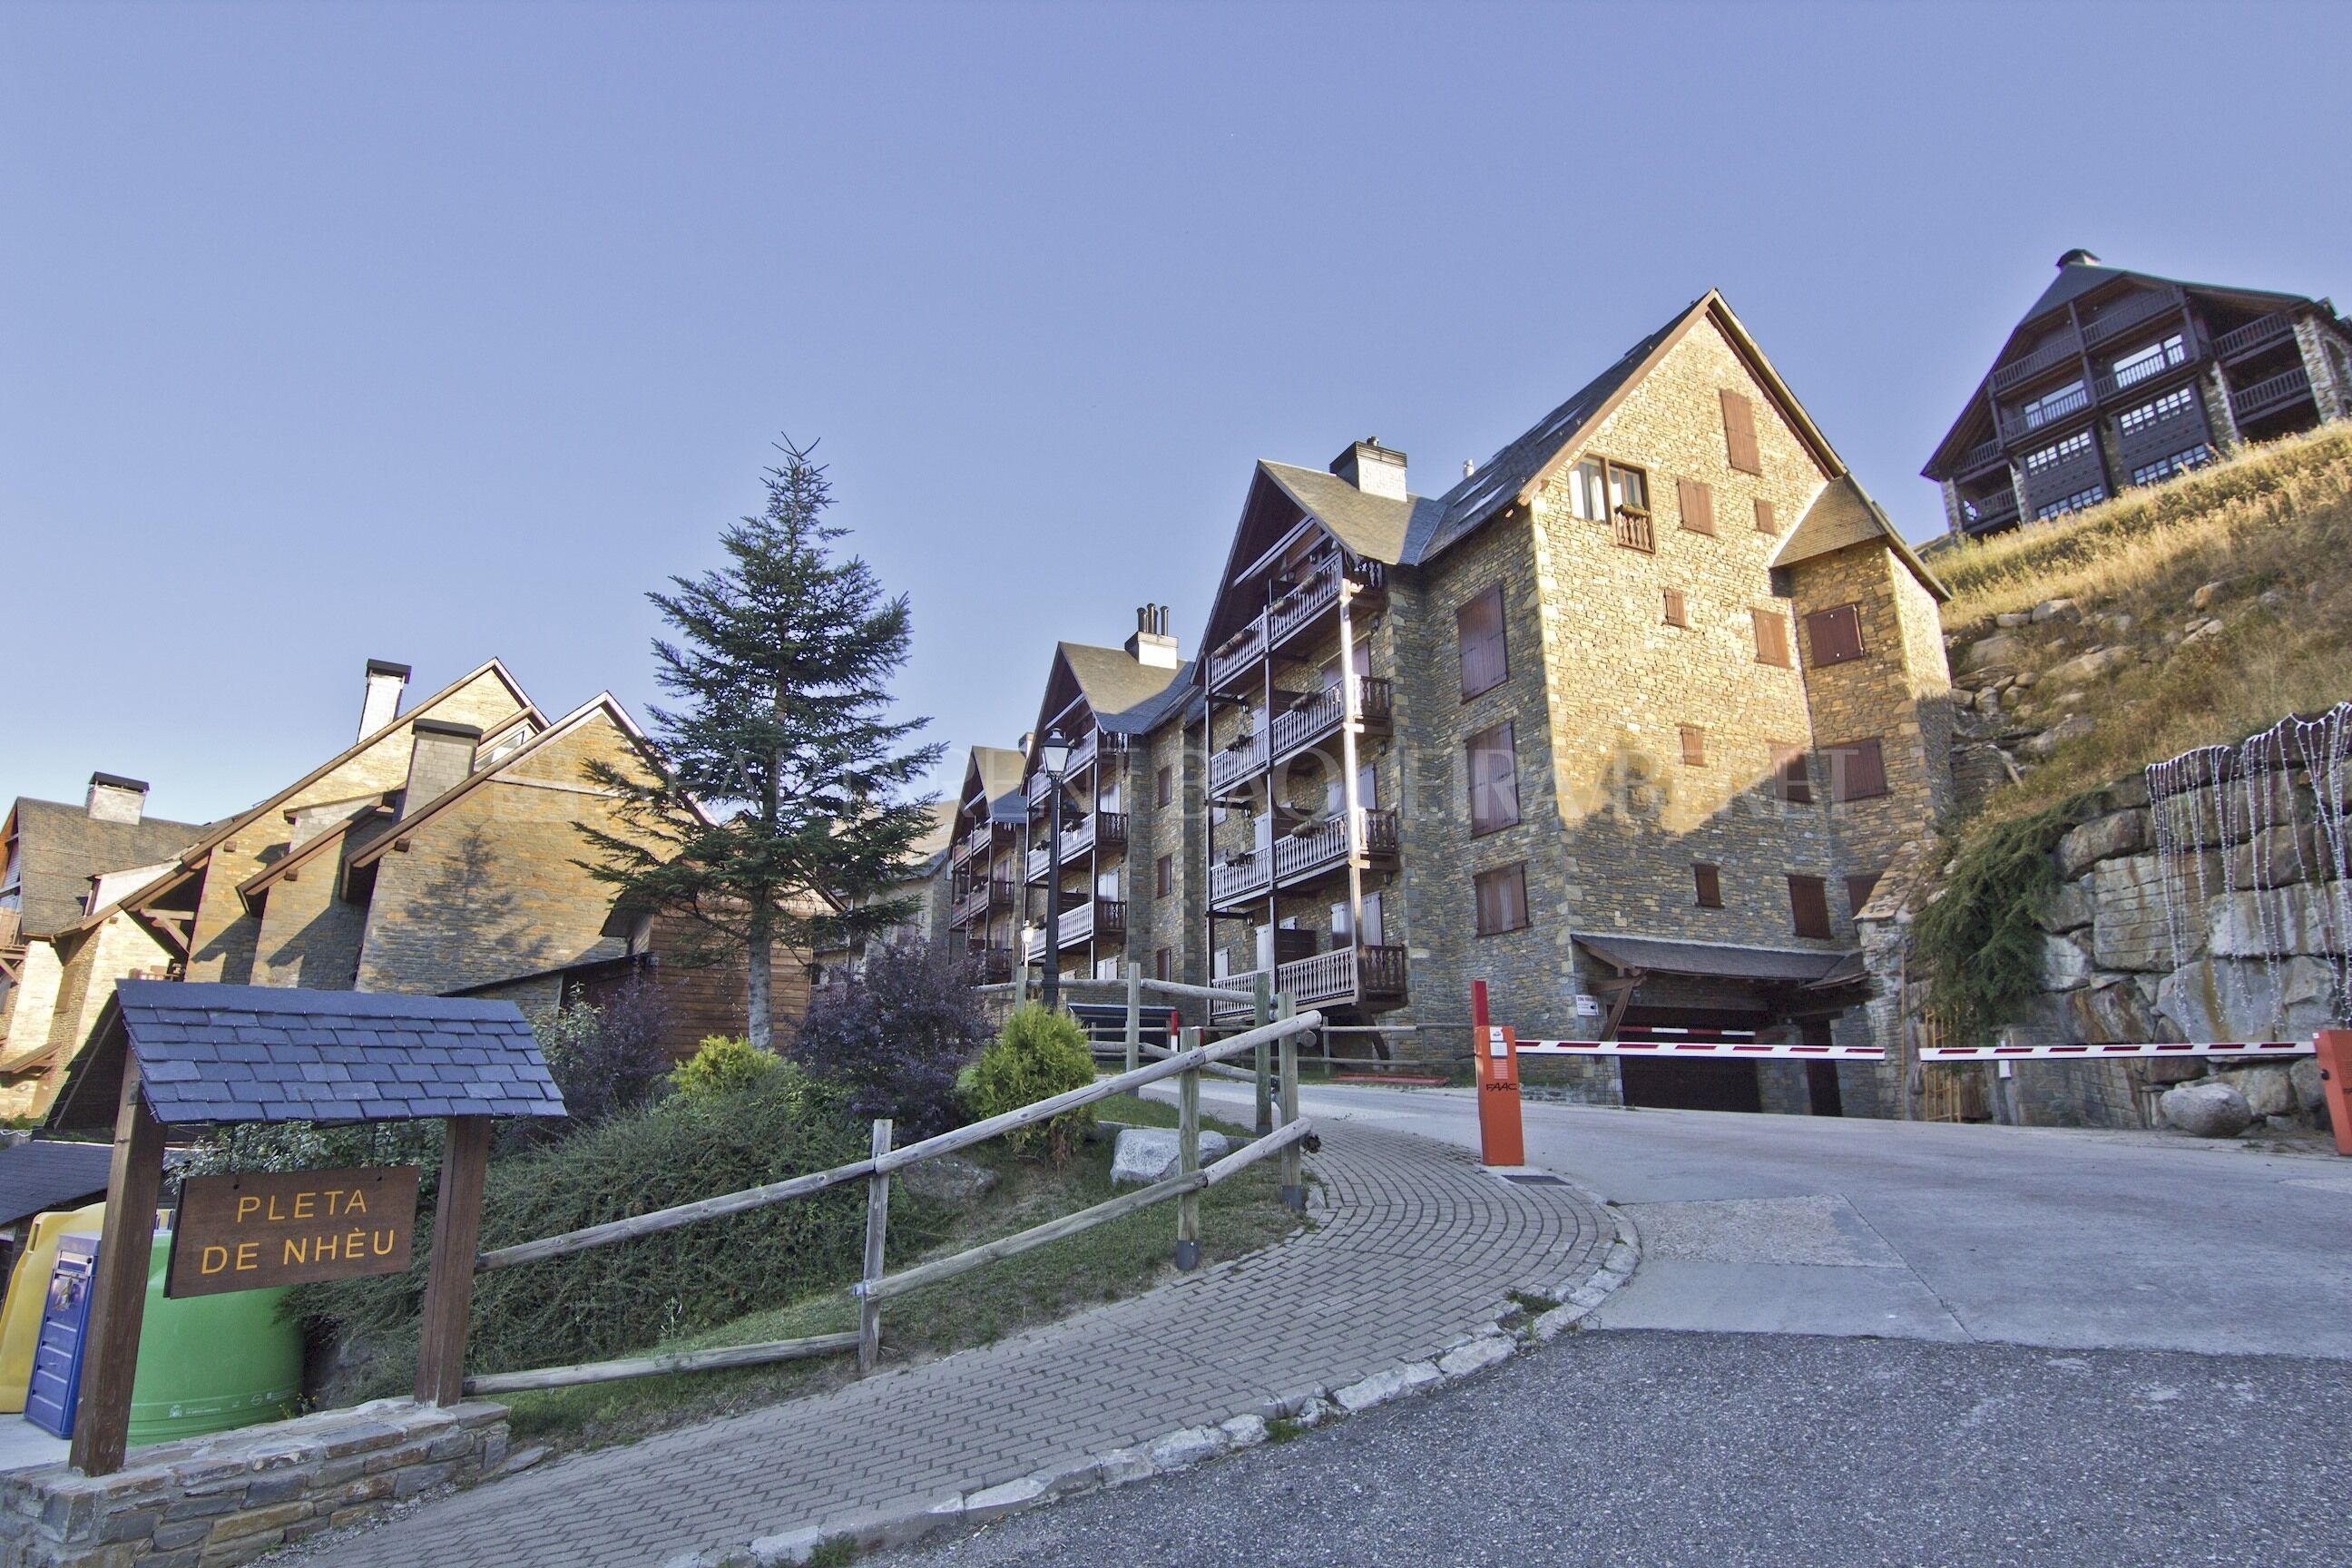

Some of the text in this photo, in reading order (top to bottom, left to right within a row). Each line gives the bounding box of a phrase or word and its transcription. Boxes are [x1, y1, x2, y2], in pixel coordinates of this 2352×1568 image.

[1485, 1083, 1517, 1092] FAAC
[237, 1190, 367, 1222] PLETA
[201, 1228, 395, 1274] DE NHÈU
